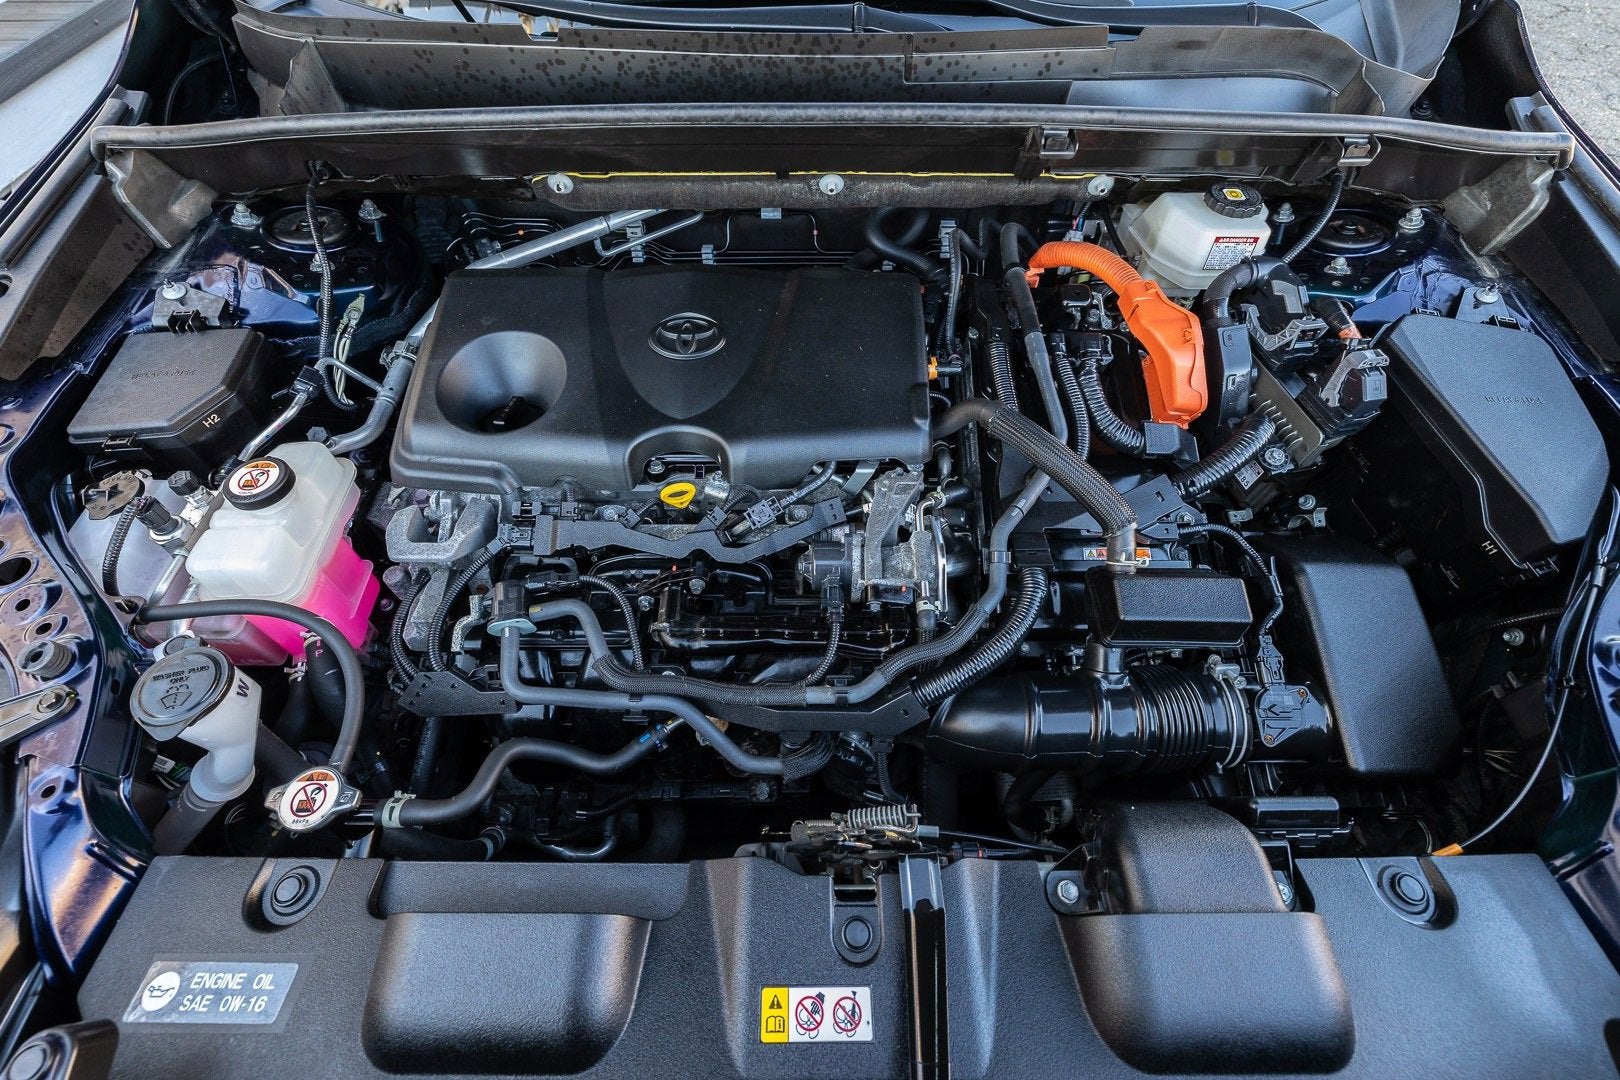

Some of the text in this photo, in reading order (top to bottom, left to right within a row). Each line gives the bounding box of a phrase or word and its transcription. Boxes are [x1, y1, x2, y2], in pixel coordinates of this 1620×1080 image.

[202, 413, 221, 428] H2
[1481, 540, 1498, 555] H1
[152, 664, 209, 682] WASHER FLUID
[170, 675, 190, 685] ONLY
[236, 677, 251, 698] W
[189, 972, 275, 989] ENGINE OIL
[178, 994, 268, 1013] SAE 0W-16
